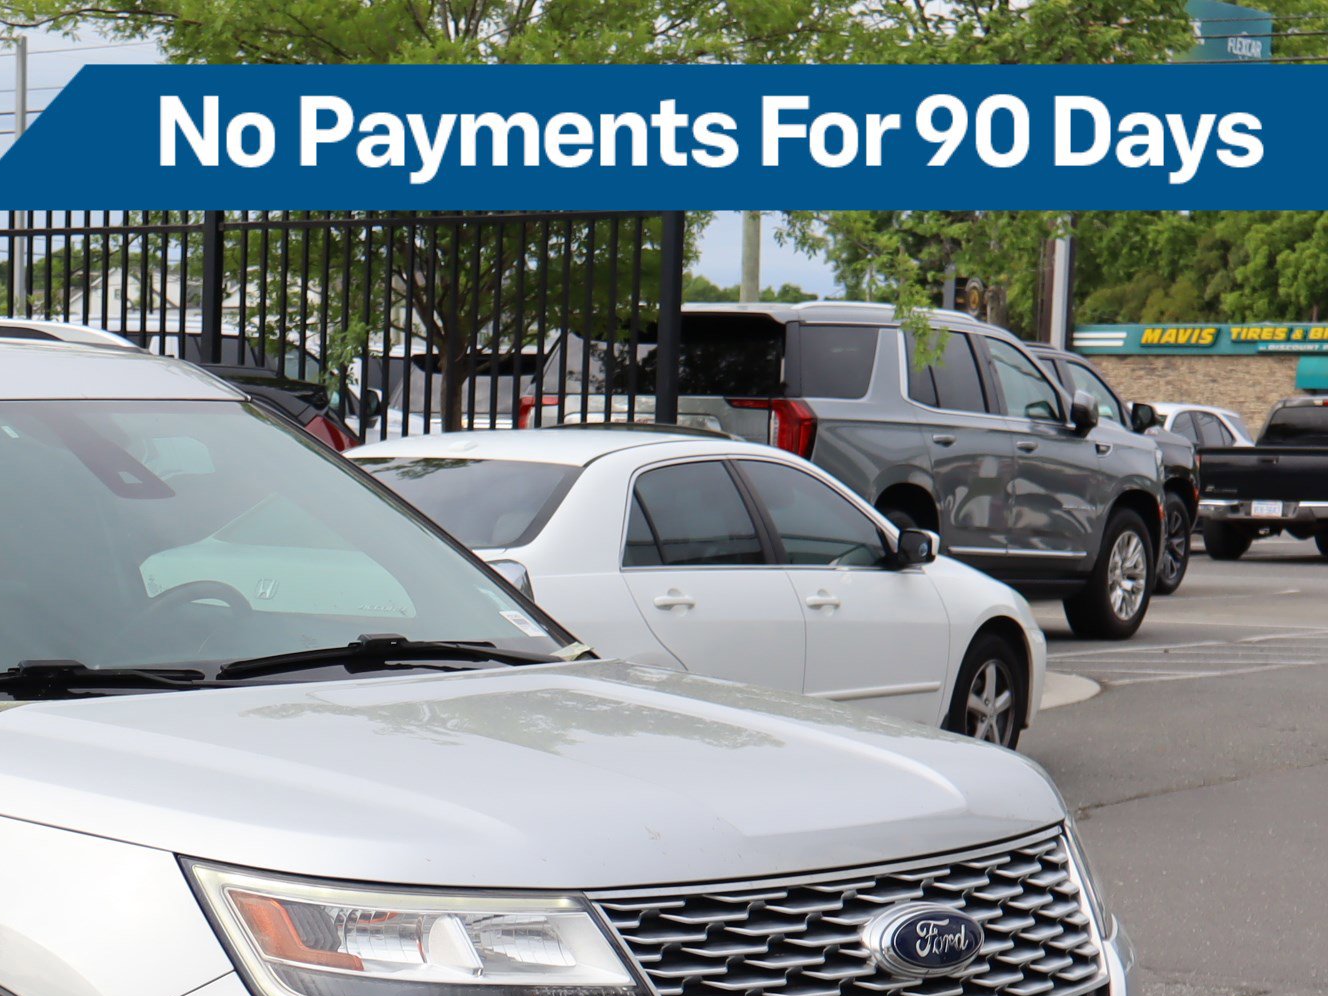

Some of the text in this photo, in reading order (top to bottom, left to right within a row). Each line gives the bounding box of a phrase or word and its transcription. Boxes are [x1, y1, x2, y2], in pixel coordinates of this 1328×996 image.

[1227, 36, 1263, 58] FLEXCAR
[1140, 327, 1218, 344] MAVIS
[1230, 327, 1289, 341] TIRES
[915, 918, 969, 958] Ford
